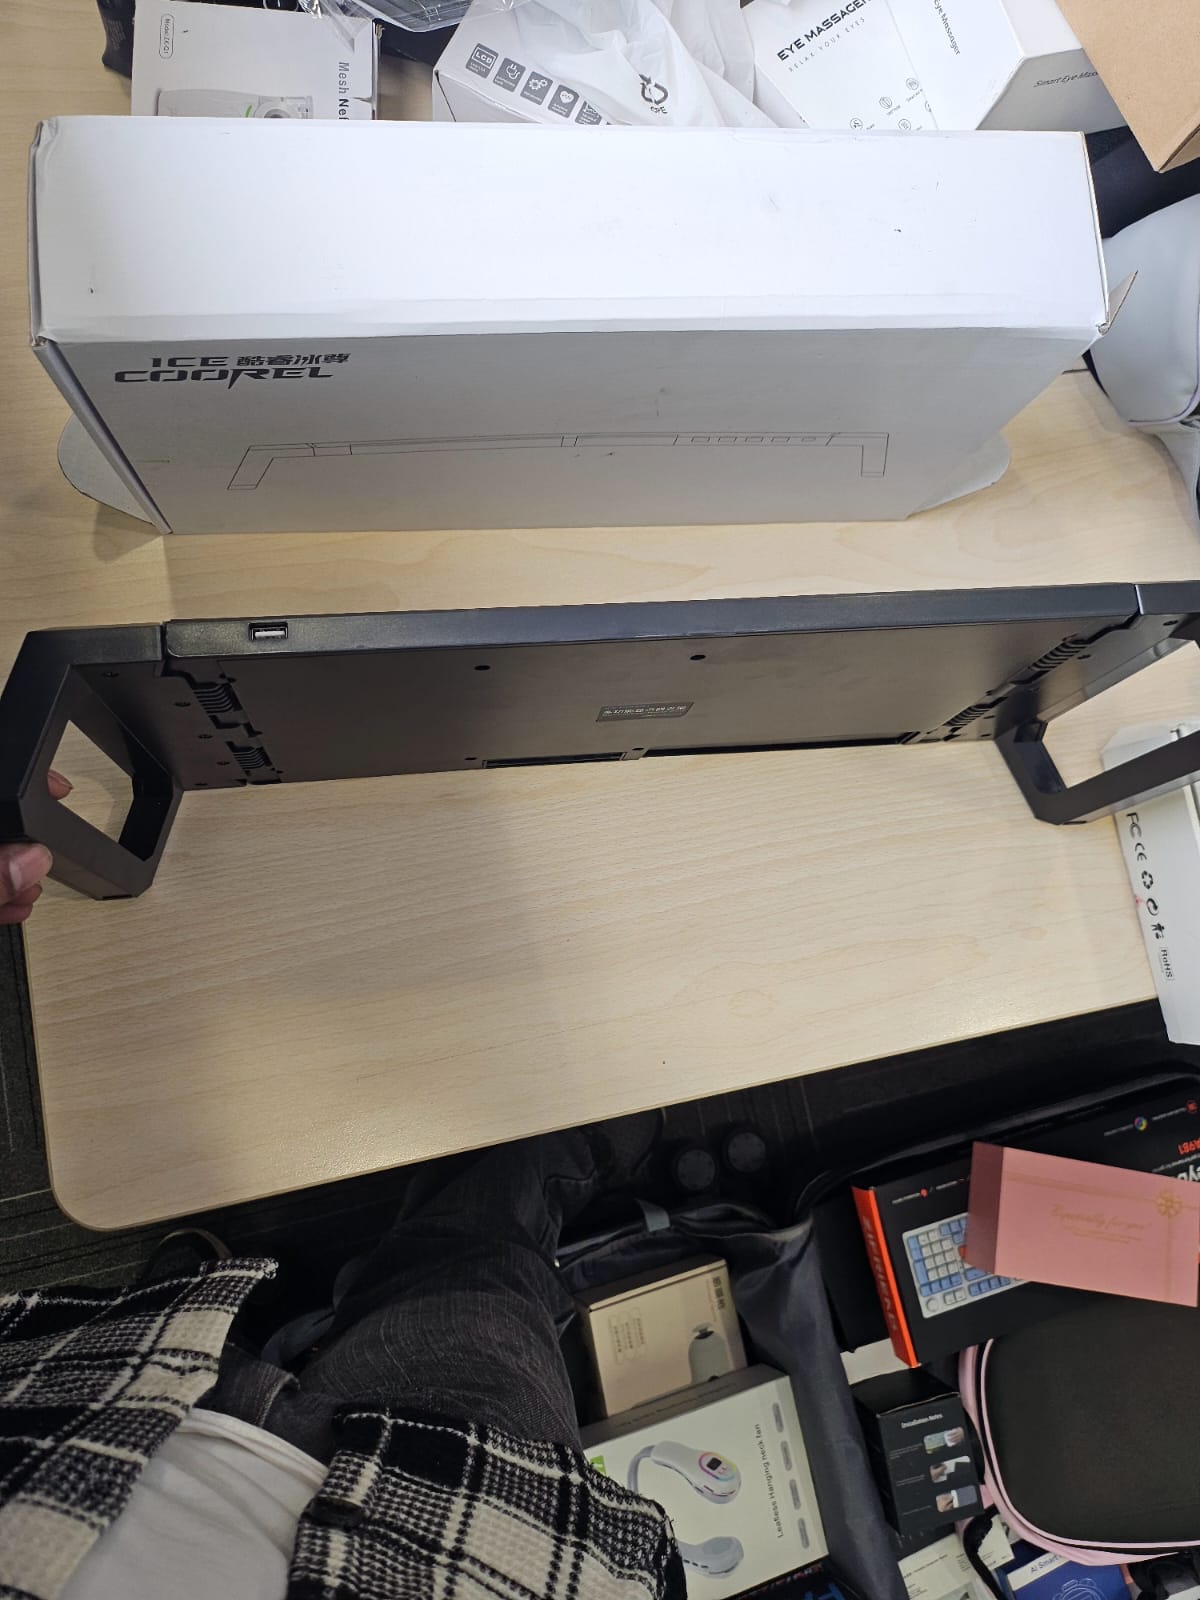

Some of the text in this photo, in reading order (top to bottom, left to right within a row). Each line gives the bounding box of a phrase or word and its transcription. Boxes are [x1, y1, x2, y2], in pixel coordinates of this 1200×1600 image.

[844, 17, 866, 32] EYES
[941, 14, 961, 55] Massager
[475, 51, 494, 65] LCD
[777, 38, 805, 62] EYE
[339, 62, 350, 94] Mesh
[150, 356, 229, 368] ICE
[114, 367, 334, 389] COOREL
[754, 1424, 762, 1439] fan
[758, 1440, 767, 1461] neck
[763, 1462, 776, 1500] Hanging
